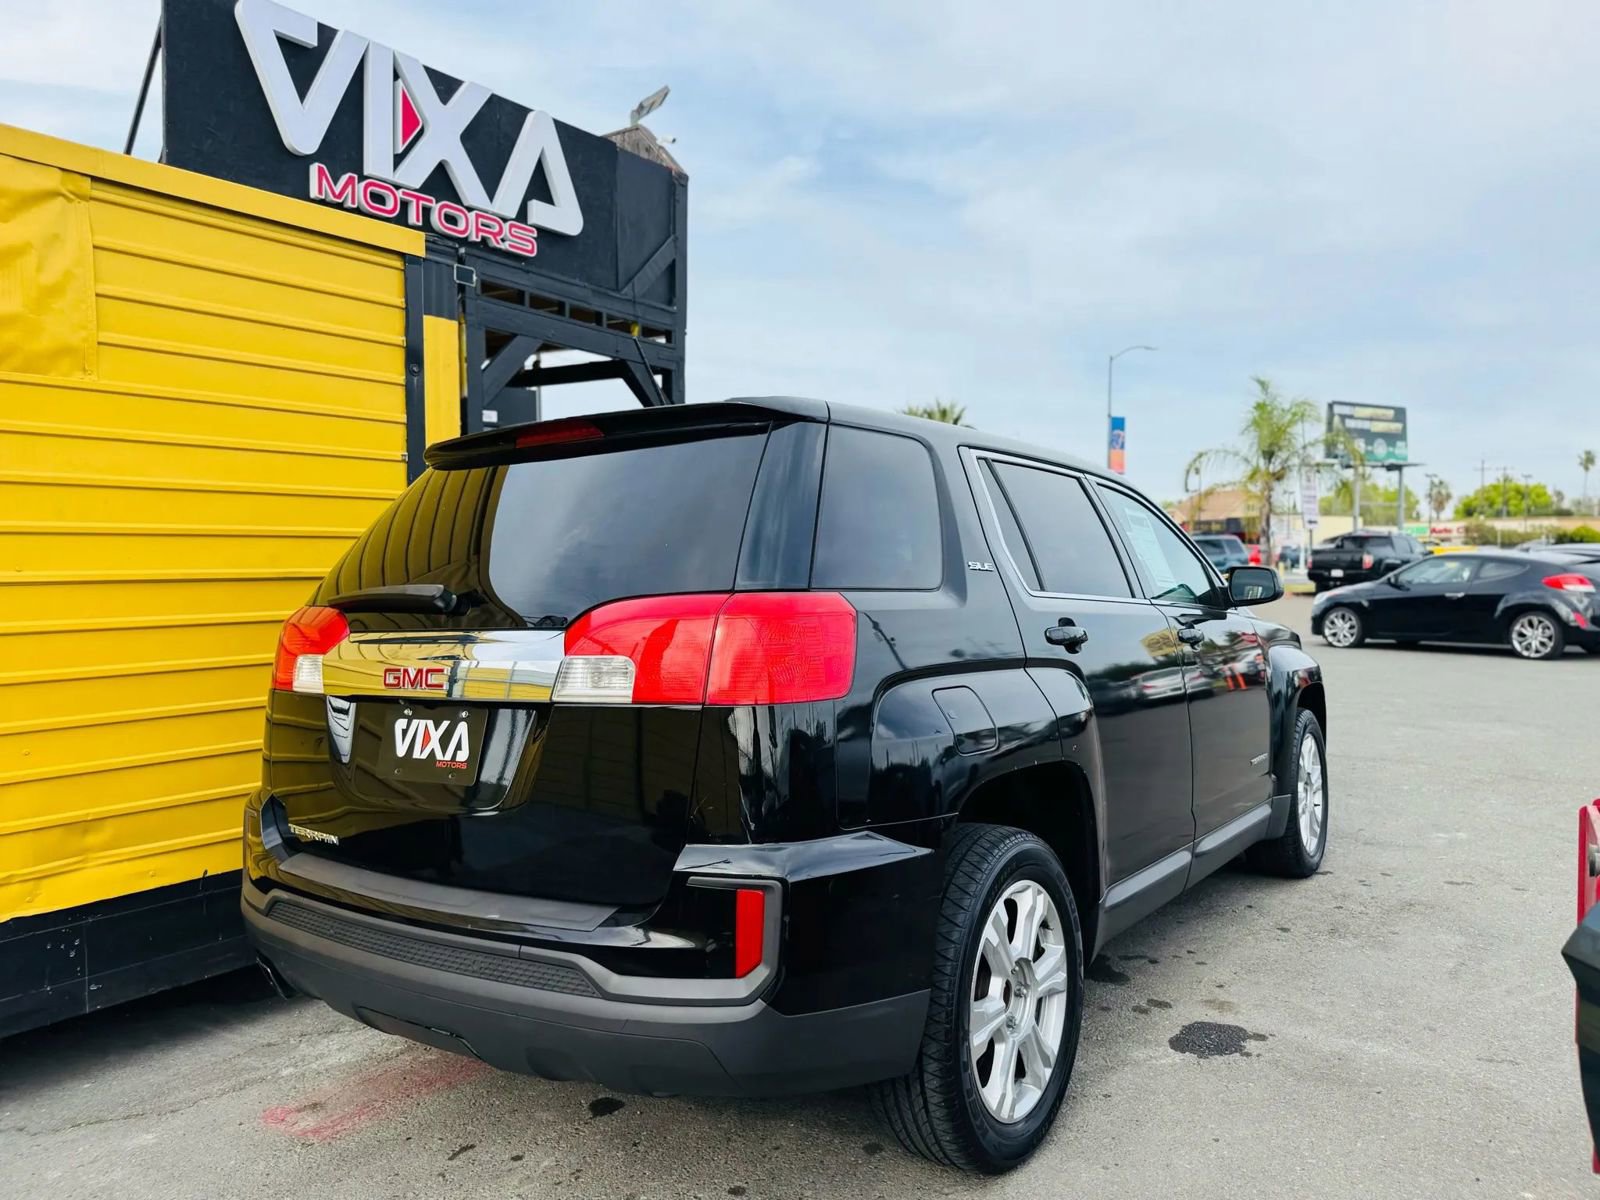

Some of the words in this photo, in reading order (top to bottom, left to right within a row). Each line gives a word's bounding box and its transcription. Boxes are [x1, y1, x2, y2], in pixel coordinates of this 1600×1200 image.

[234, 0, 583, 236] VIXA
[309, 162, 538, 257] MOTORS
[383, 667, 449, 690] GMC
[394, 718, 470, 762] VIXA
[435, 760, 467, 769] MOTORS
